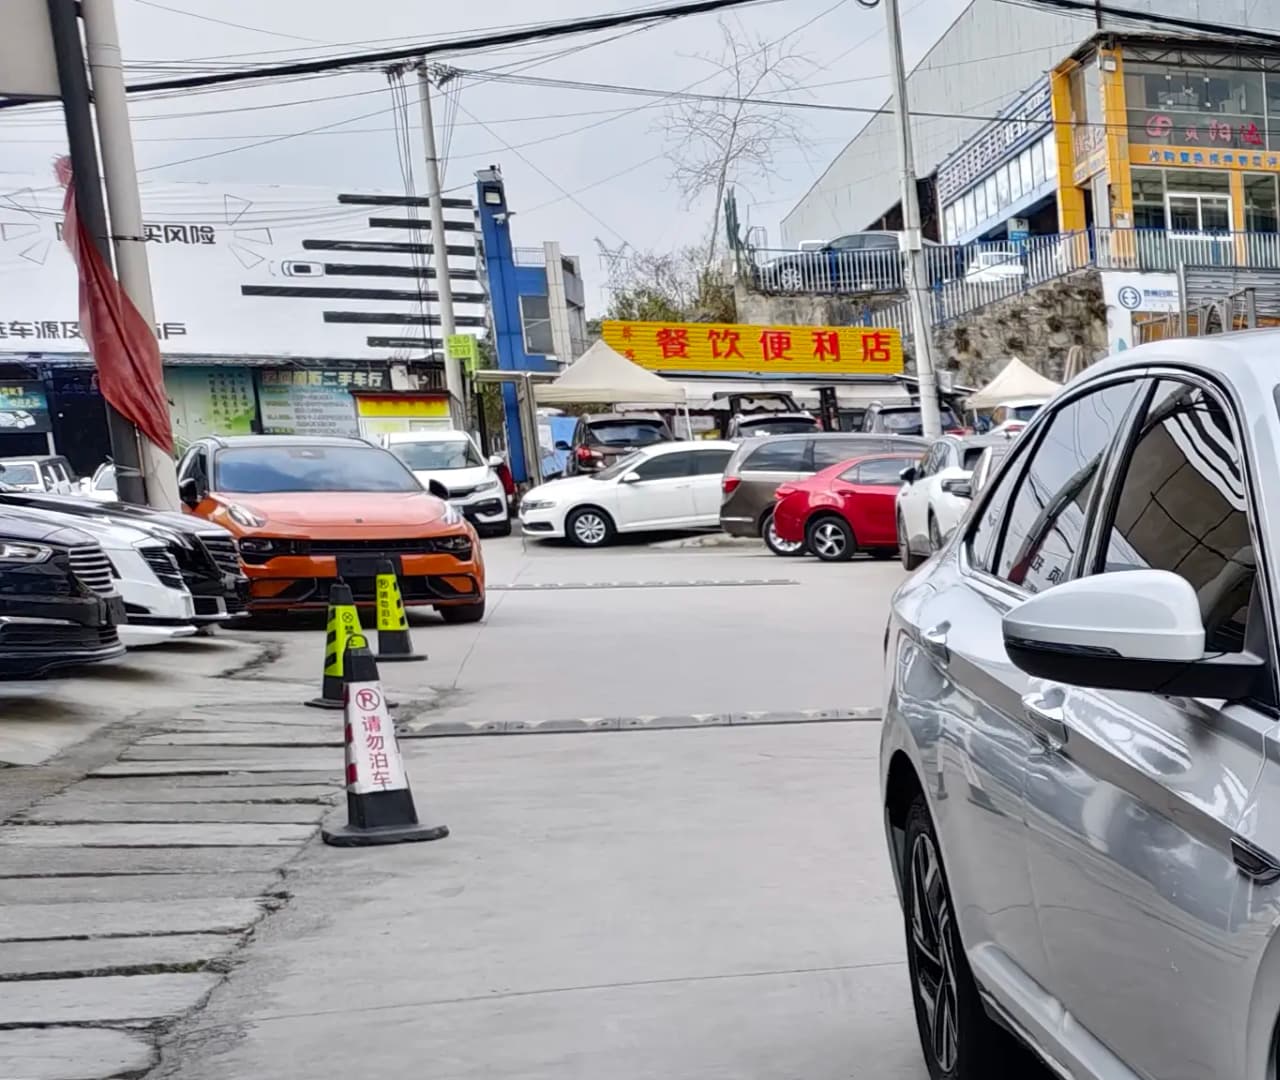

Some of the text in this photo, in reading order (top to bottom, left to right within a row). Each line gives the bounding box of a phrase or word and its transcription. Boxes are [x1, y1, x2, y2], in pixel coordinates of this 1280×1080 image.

[656, 327, 892, 363] 餐饮便利店
[361, 715, 392, 788] 请勿泊车
